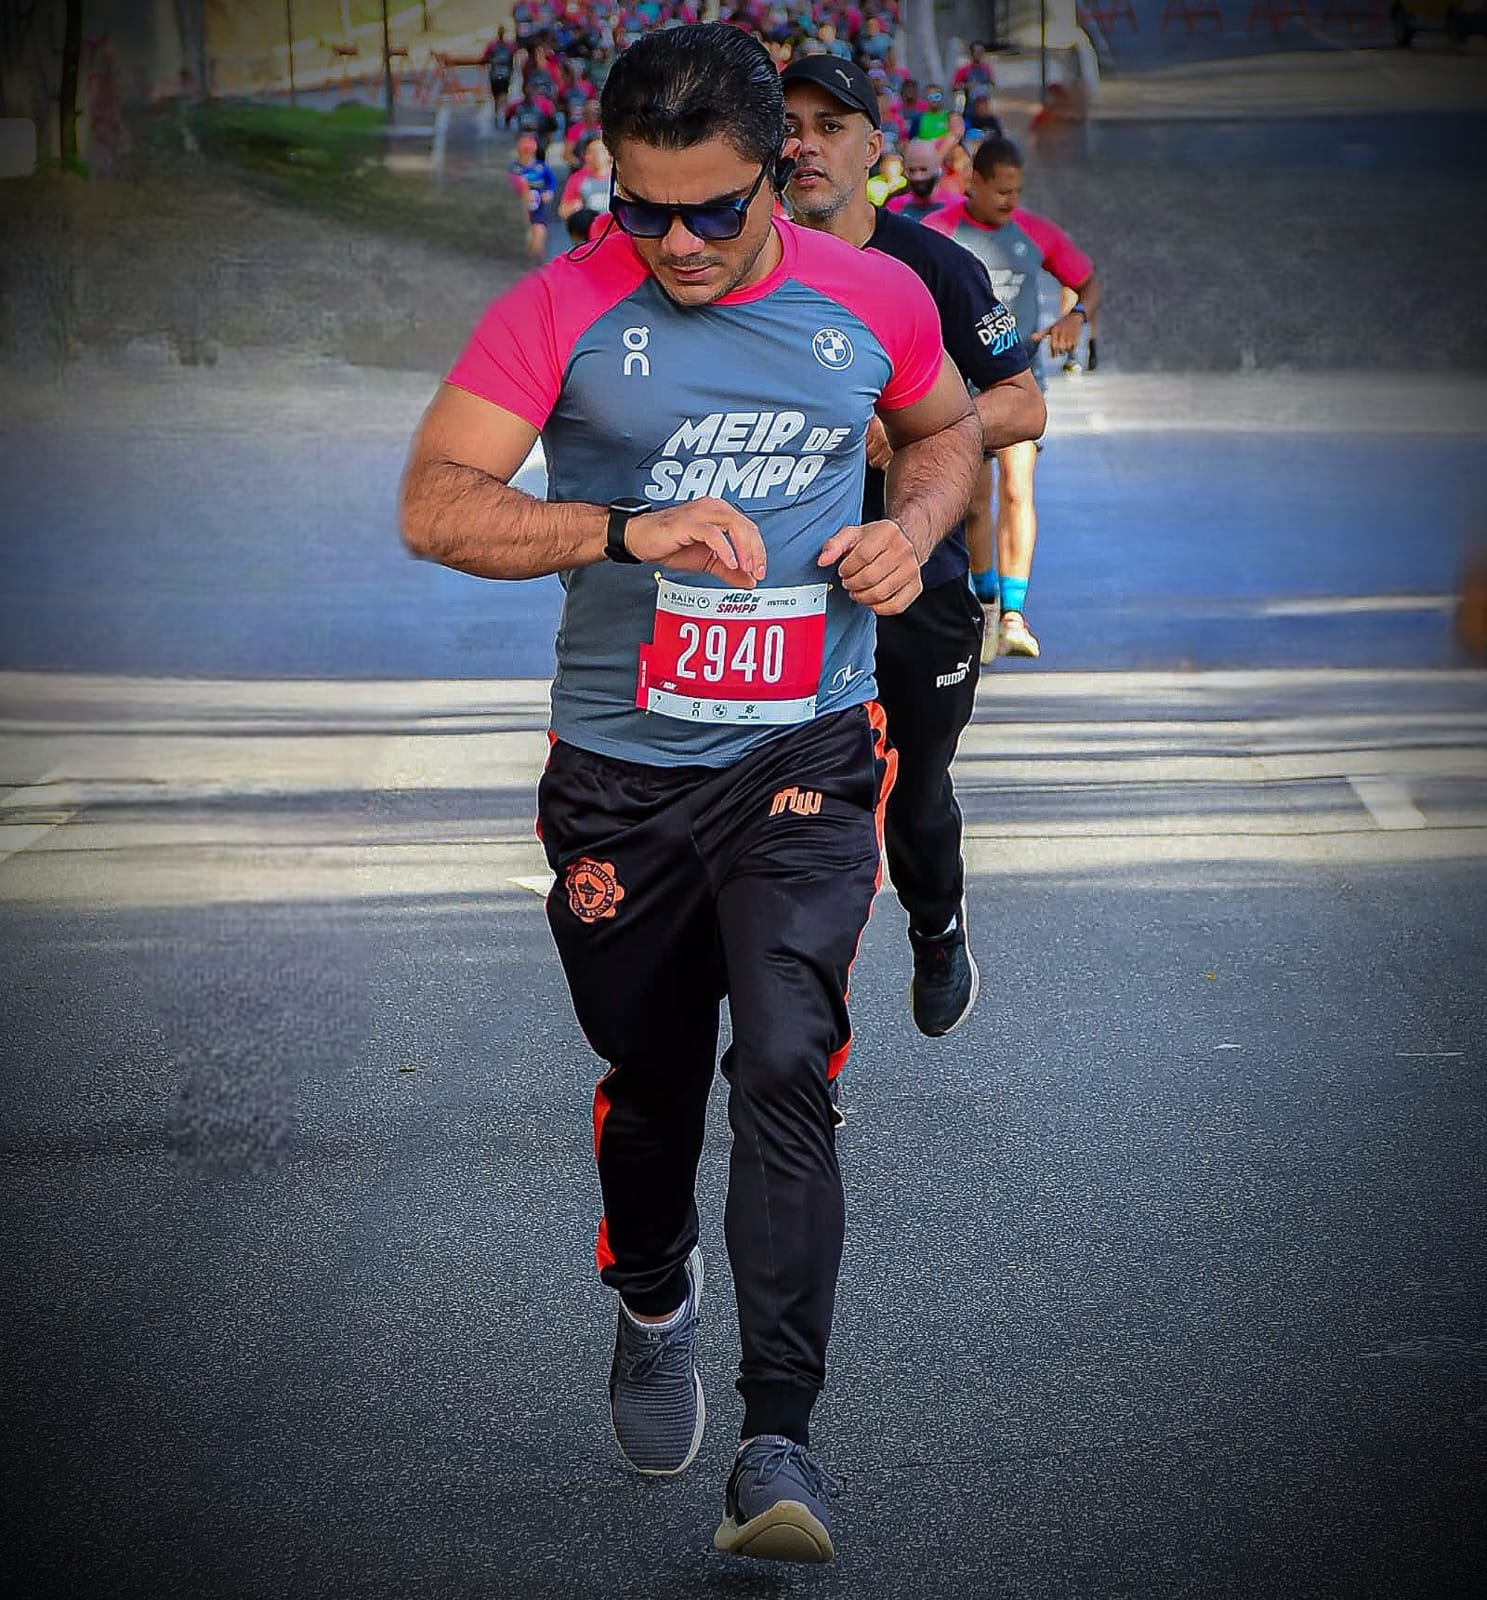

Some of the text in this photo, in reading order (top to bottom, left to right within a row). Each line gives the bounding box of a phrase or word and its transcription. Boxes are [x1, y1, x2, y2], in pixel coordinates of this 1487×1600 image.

[801, 427, 852, 452] DE
[644, 454, 826, 501] SAMPA
[671, 592, 696, 604] BAIN
[676, 622, 785, 684] 2940
[936, 668, 967, 688] PUMA
